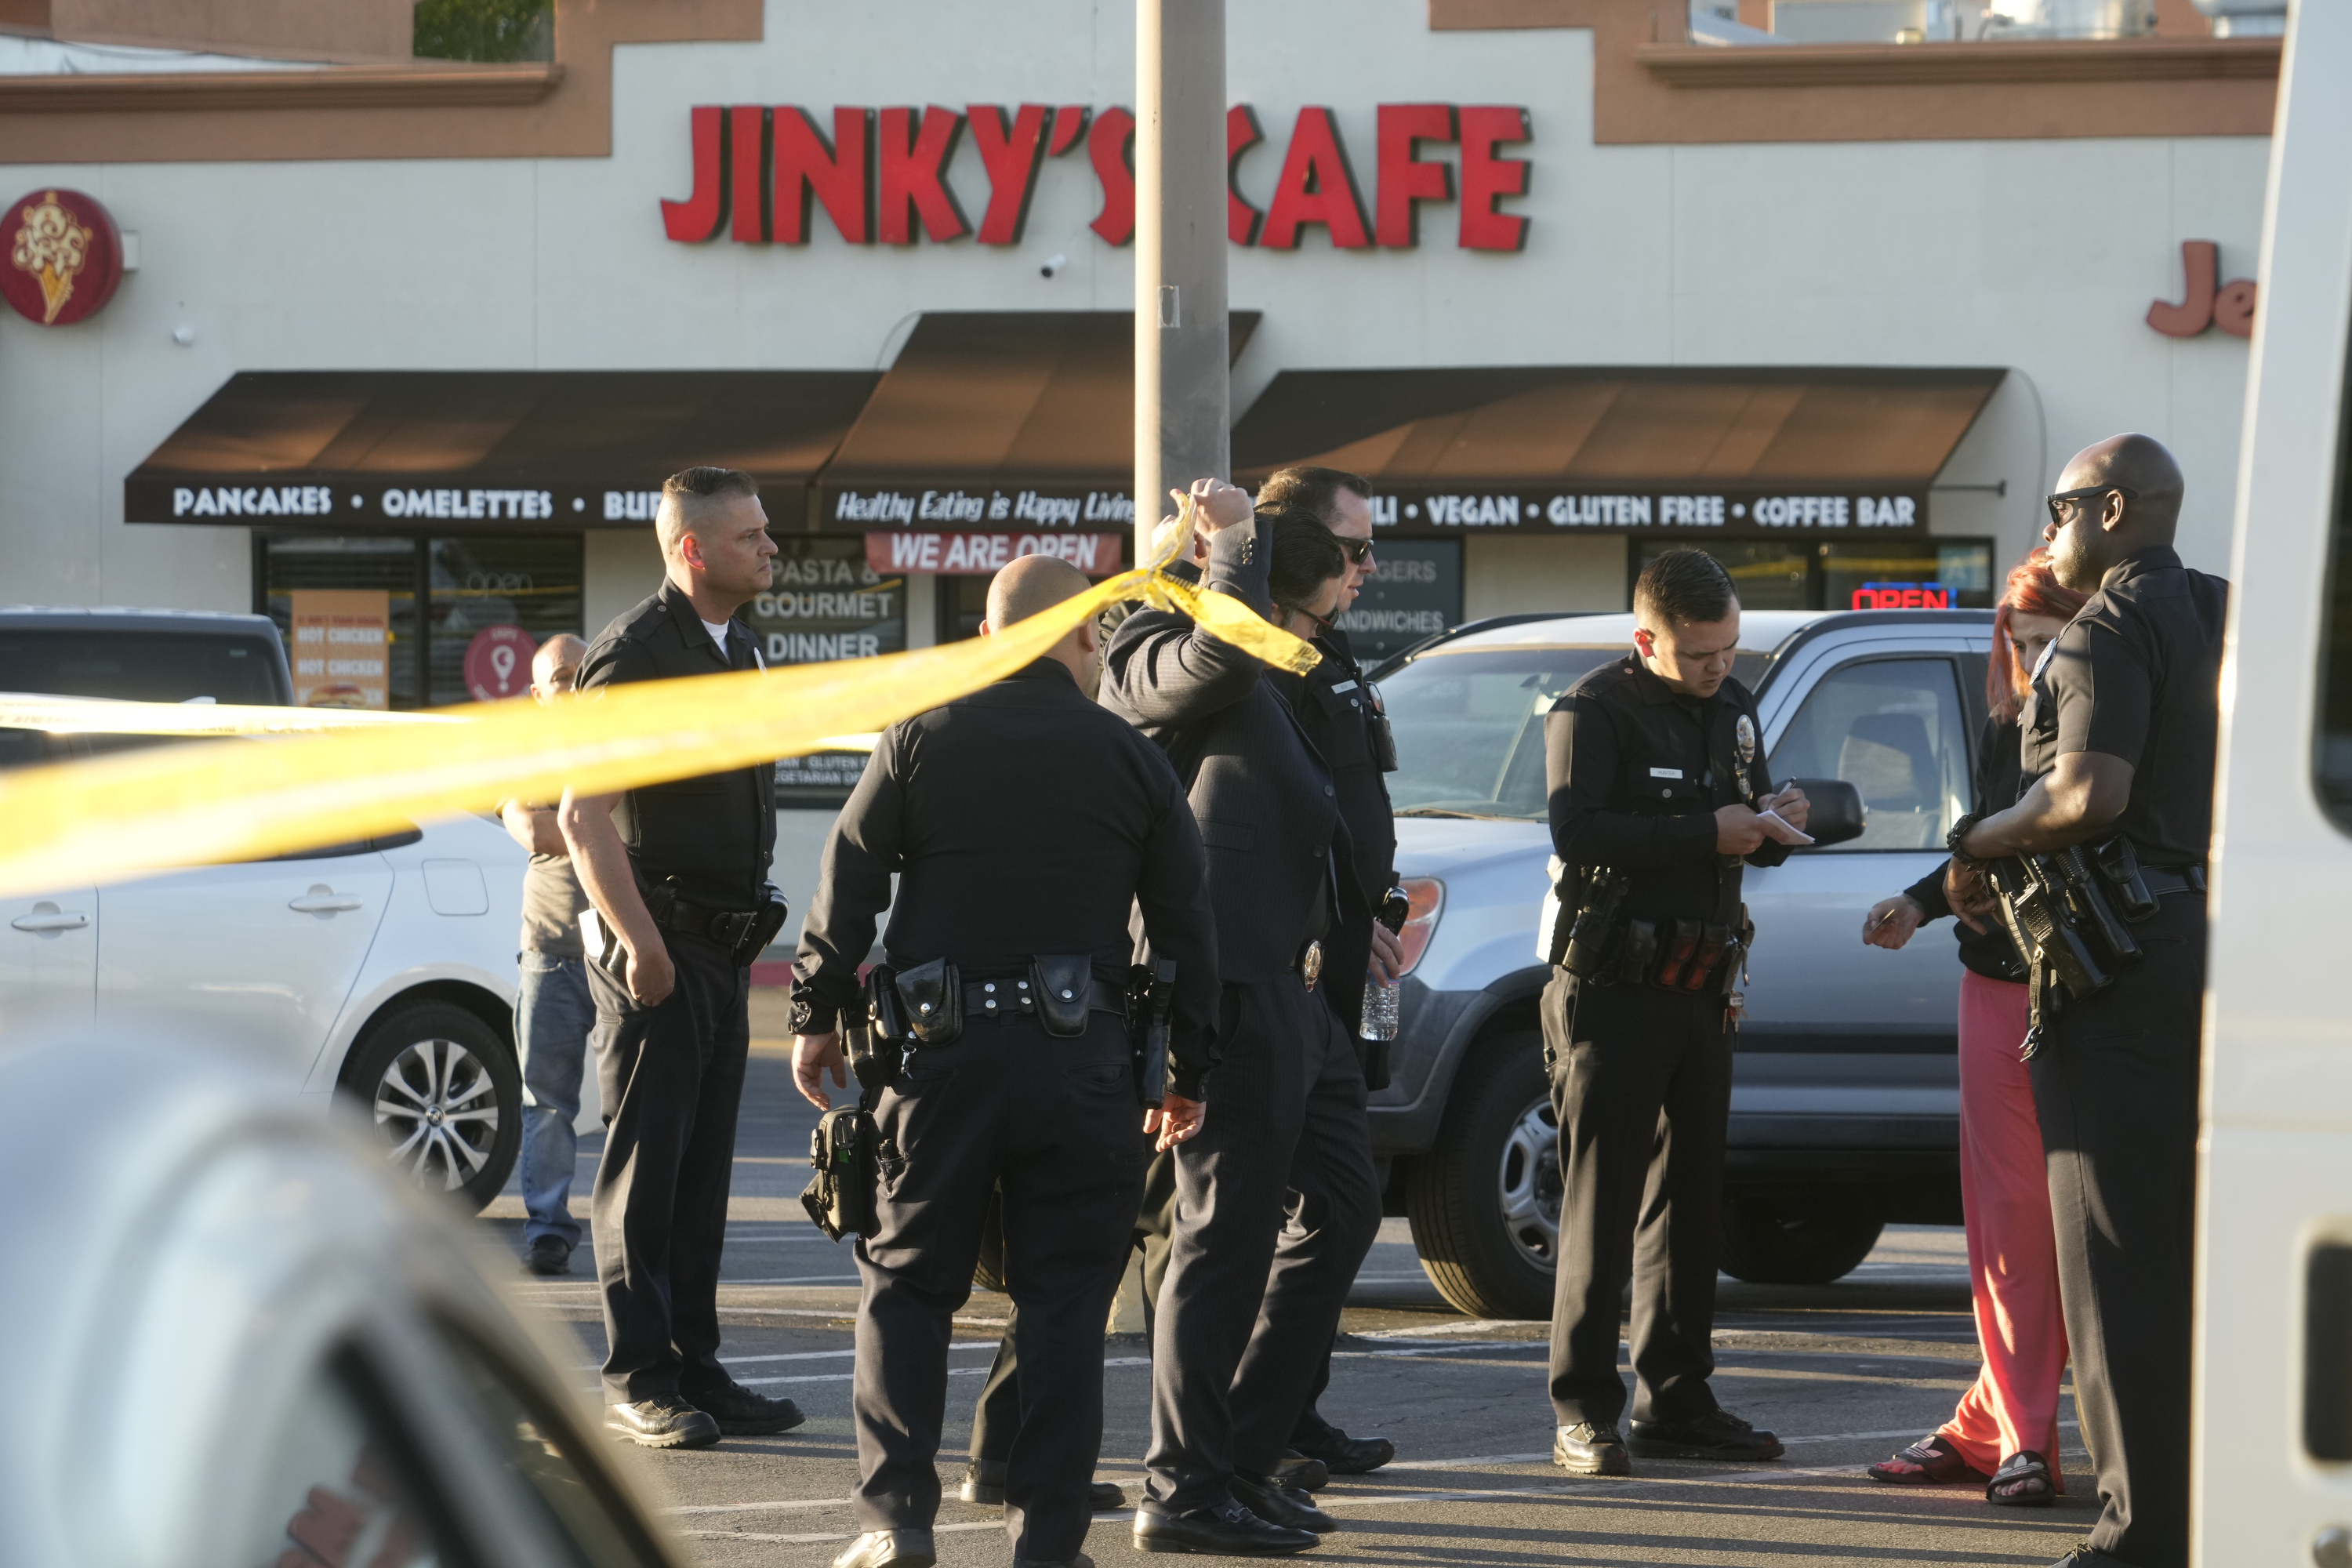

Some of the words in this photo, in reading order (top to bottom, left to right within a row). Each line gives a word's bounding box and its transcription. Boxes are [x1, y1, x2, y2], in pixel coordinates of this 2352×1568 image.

[173, 487, 332, 516] PANCAKES
[383, 488, 553, 519] OMELETTES
[836, 491, 915, 526] Healthy
[918, 490, 985, 523] Eating
[988, 490, 1011, 521] is
[1014, 490, 1080, 527] Happy
[1426, 495, 1519, 526] VEGAN
[1547, 495, 1651, 526] GLUTEN
[1659, 495, 1725, 526] FREE
[1752, 496, 1849, 527] COFFEE
[1857, 496, 1915, 527] BAR
[891, 533, 940, 569] WE
[944, 534, 1010, 570] ARE
[1015, 534, 1098, 569] OPEN
[771, 559, 855, 585] PASTA
[1365, 559, 1437, 583] GERS
[754, 591, 894, 619] GOURMET
[1852, 589, 1948, 609] OPEN
[767, 632, 880, 662] DINNER
[808, 756, 858, 770] GLUTEN
